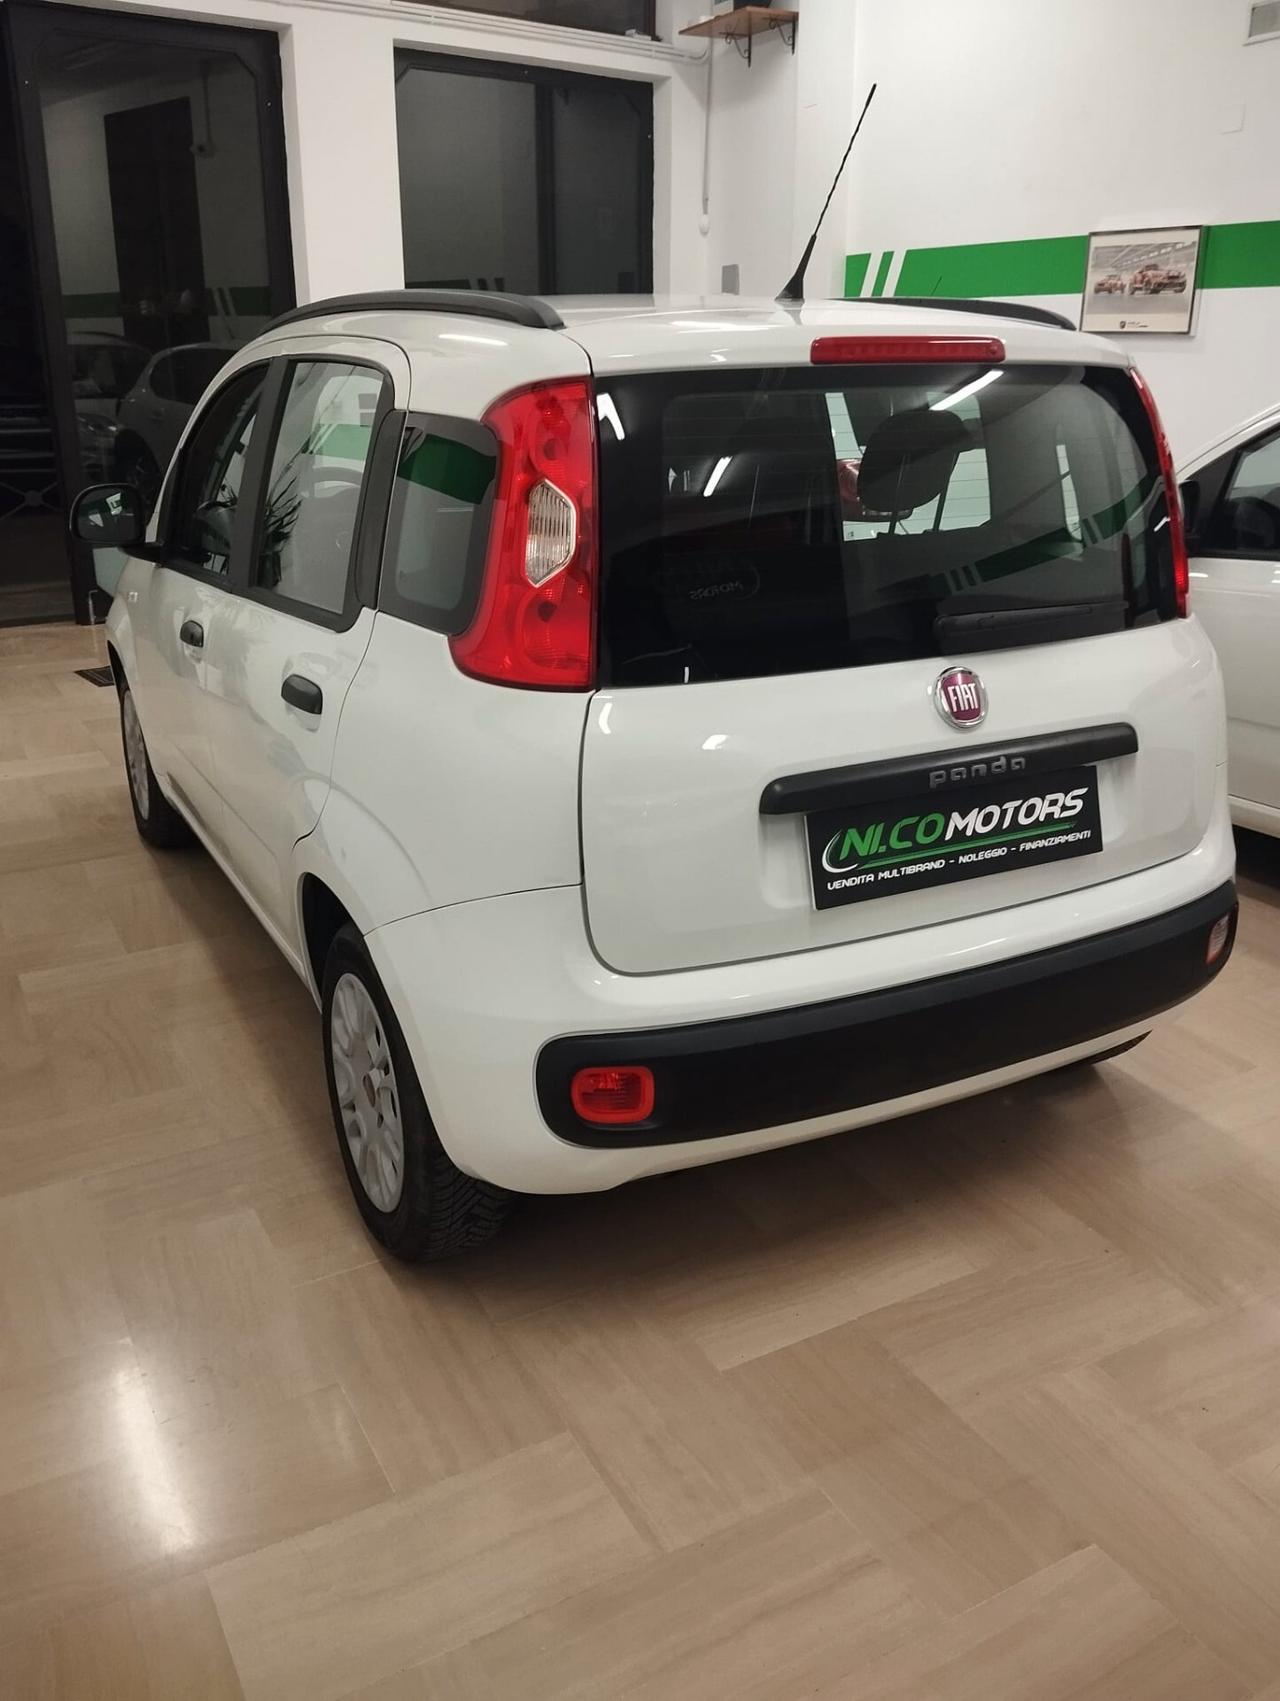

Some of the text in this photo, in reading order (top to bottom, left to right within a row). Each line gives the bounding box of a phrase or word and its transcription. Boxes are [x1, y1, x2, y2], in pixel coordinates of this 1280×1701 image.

[947, 683, 979, 713] FIAT
[929, 755, 1026, 789] panda
[827, 873, 875, 891] VENDITA
[877, 859, 946, 881] MULTIBRAND
[958, 847, 1008, 865] NOLEGGIO
[1019, 829, 1092, 852] FINANZIAMENTI
